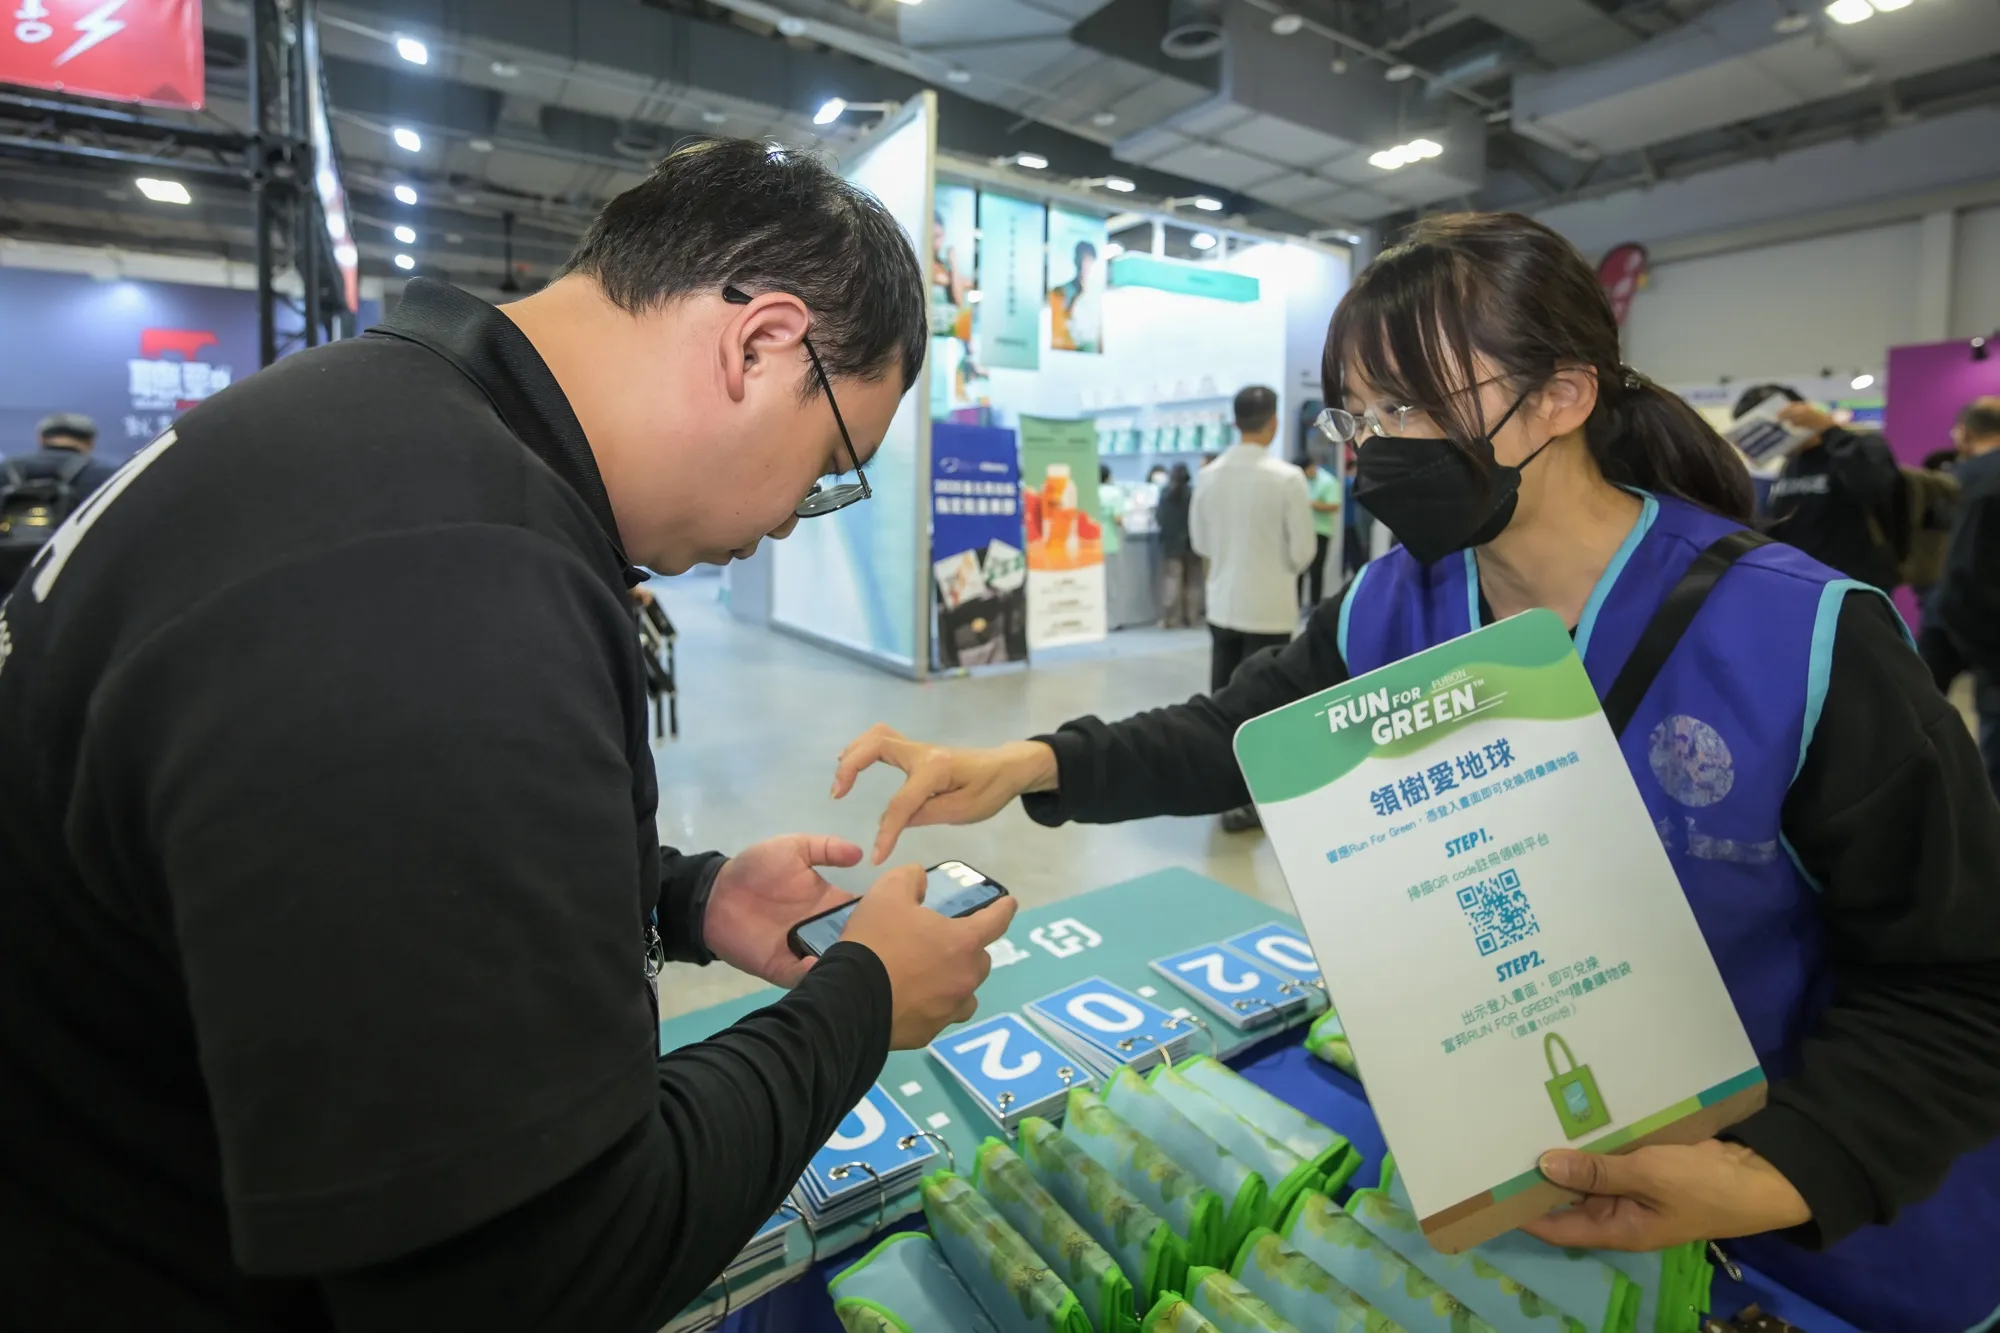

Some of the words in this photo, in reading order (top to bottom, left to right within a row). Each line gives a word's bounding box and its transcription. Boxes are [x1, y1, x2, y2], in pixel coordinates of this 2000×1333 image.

[1327, 687, 1390, 734] RUN
[1392, 686, 1422, 709] FOR
[1369, 737, 1516, 818] 領樹愛地球
[1370, 833, 1386, 845] For
[1444, 827, 1494, 859] STEP1.
[1496, 950, 1545, 983] STEP2.
